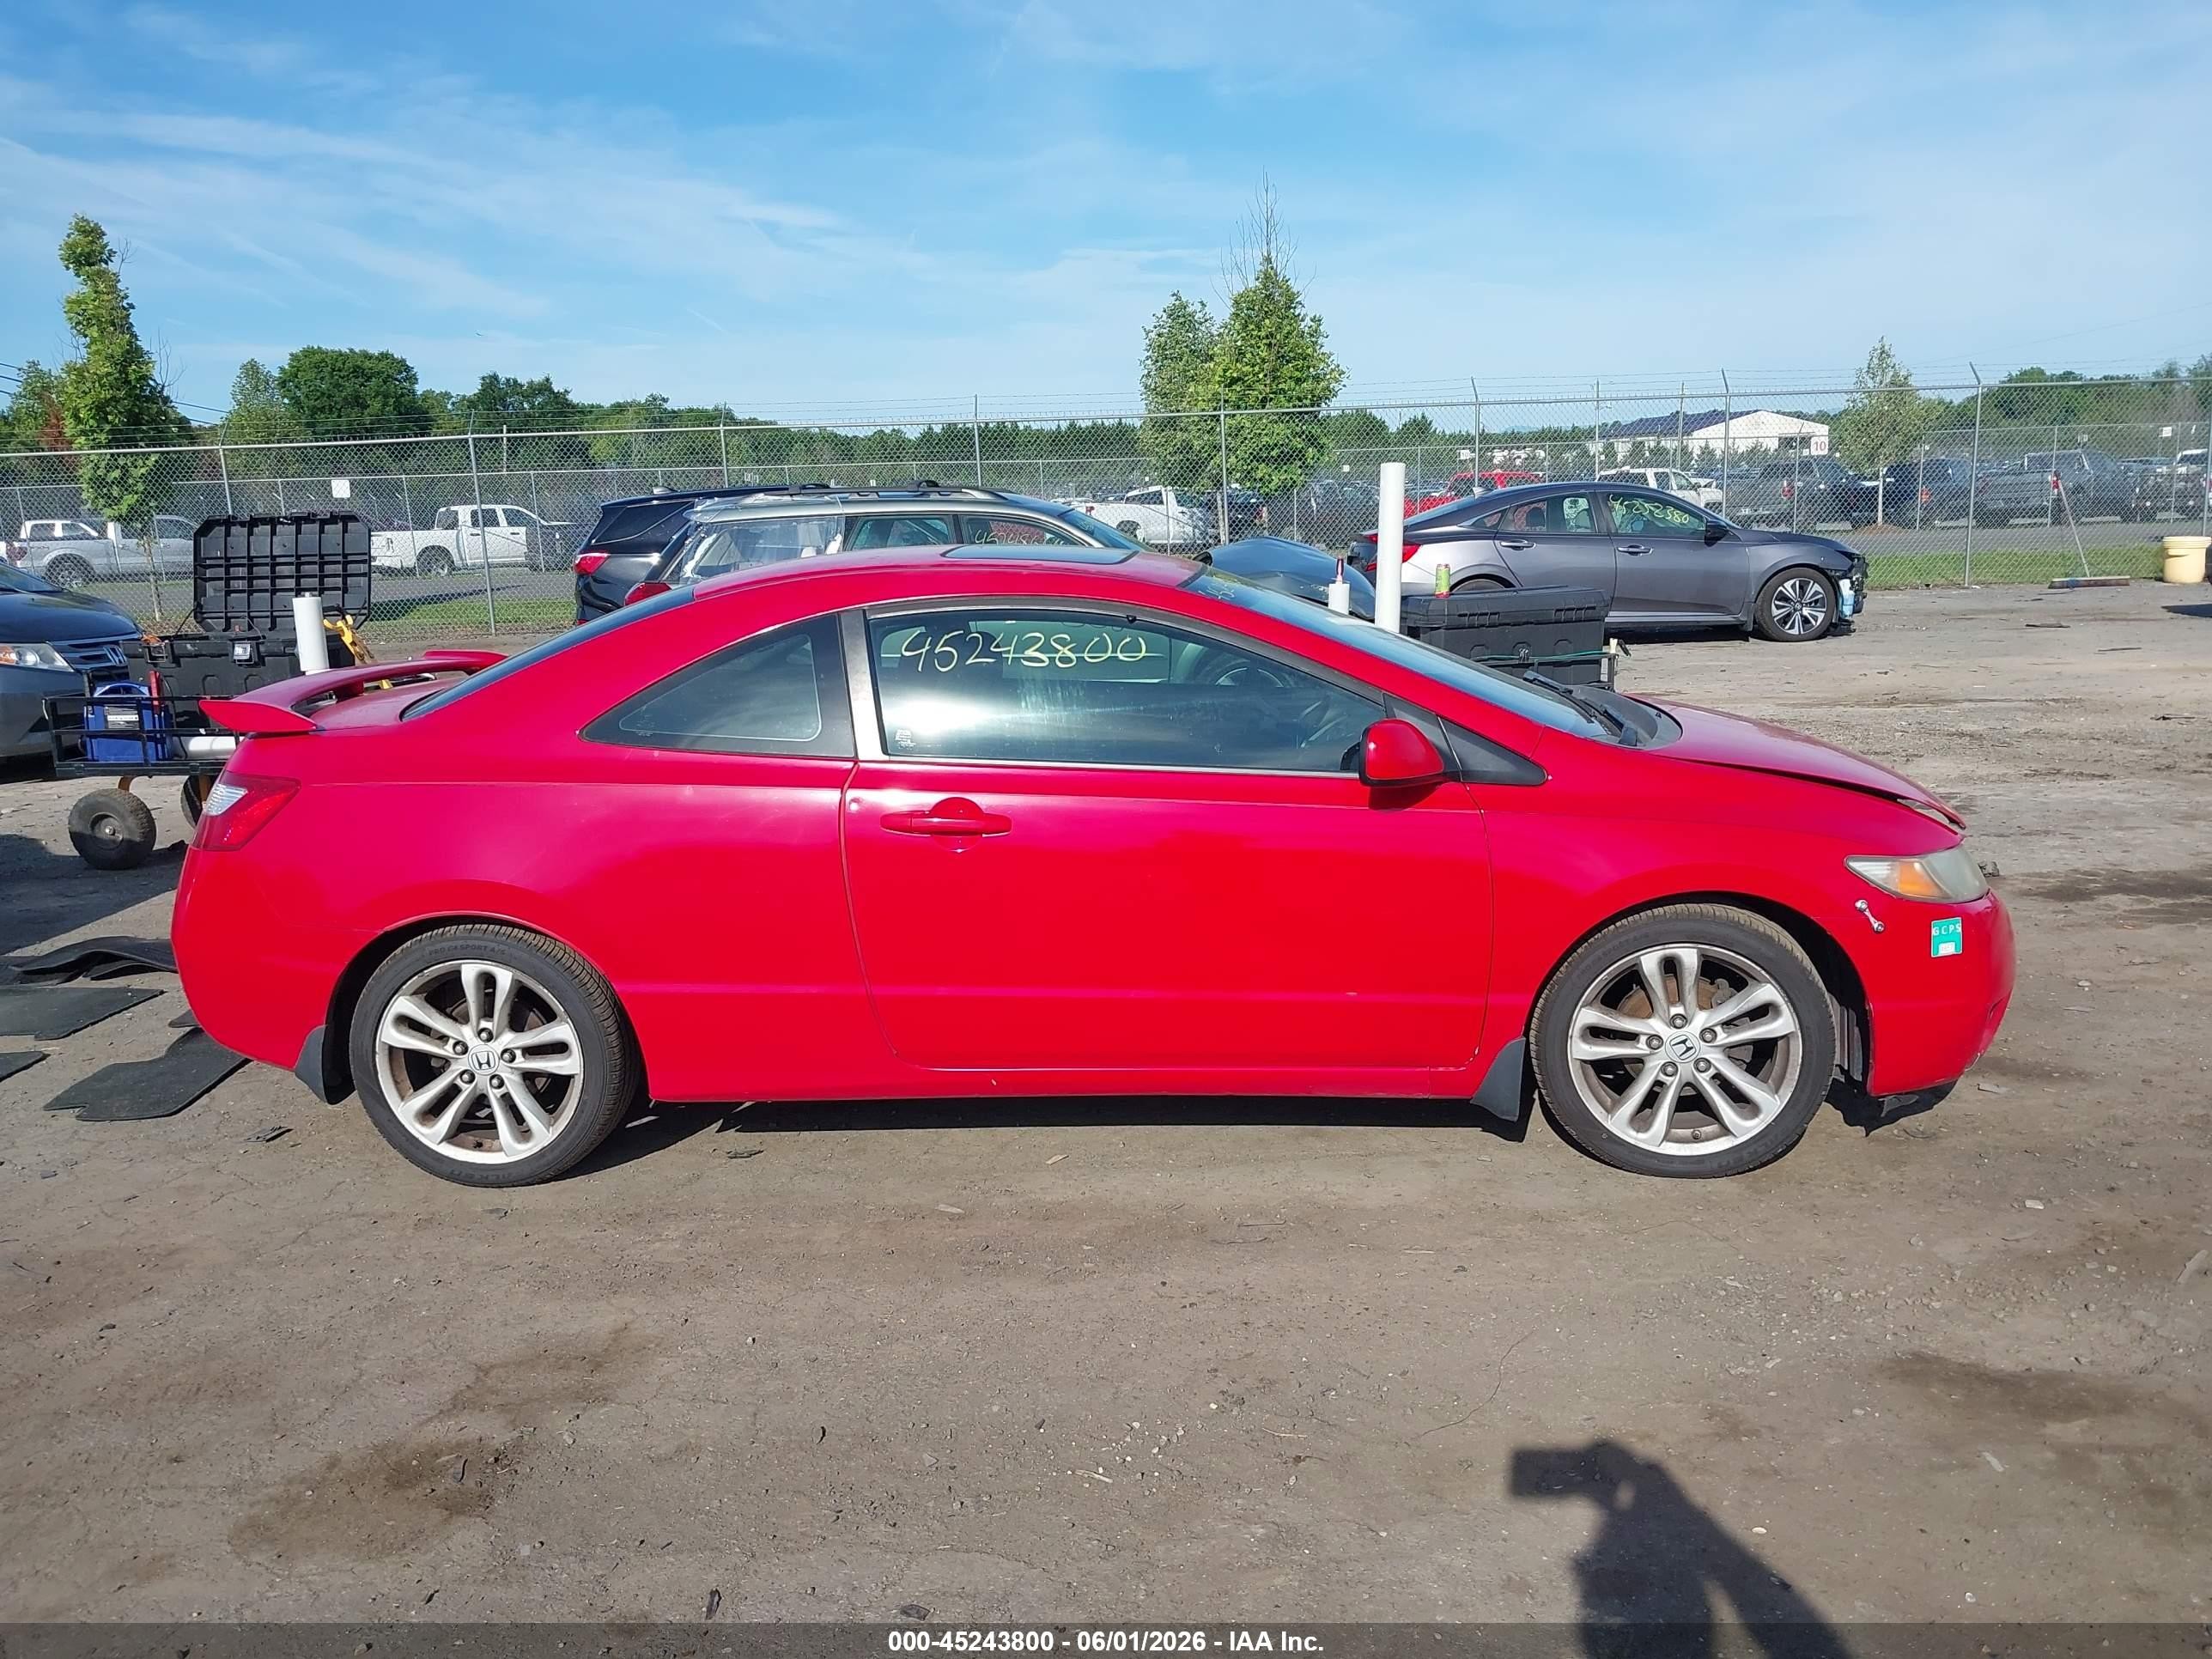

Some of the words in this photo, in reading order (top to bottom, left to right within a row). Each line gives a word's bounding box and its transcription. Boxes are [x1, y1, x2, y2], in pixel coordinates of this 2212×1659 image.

[1813, 441, 1826, 452] 10
[1609, 494, 1690, 524] 45252380
[902, 629, 1148, 673] 45243800
